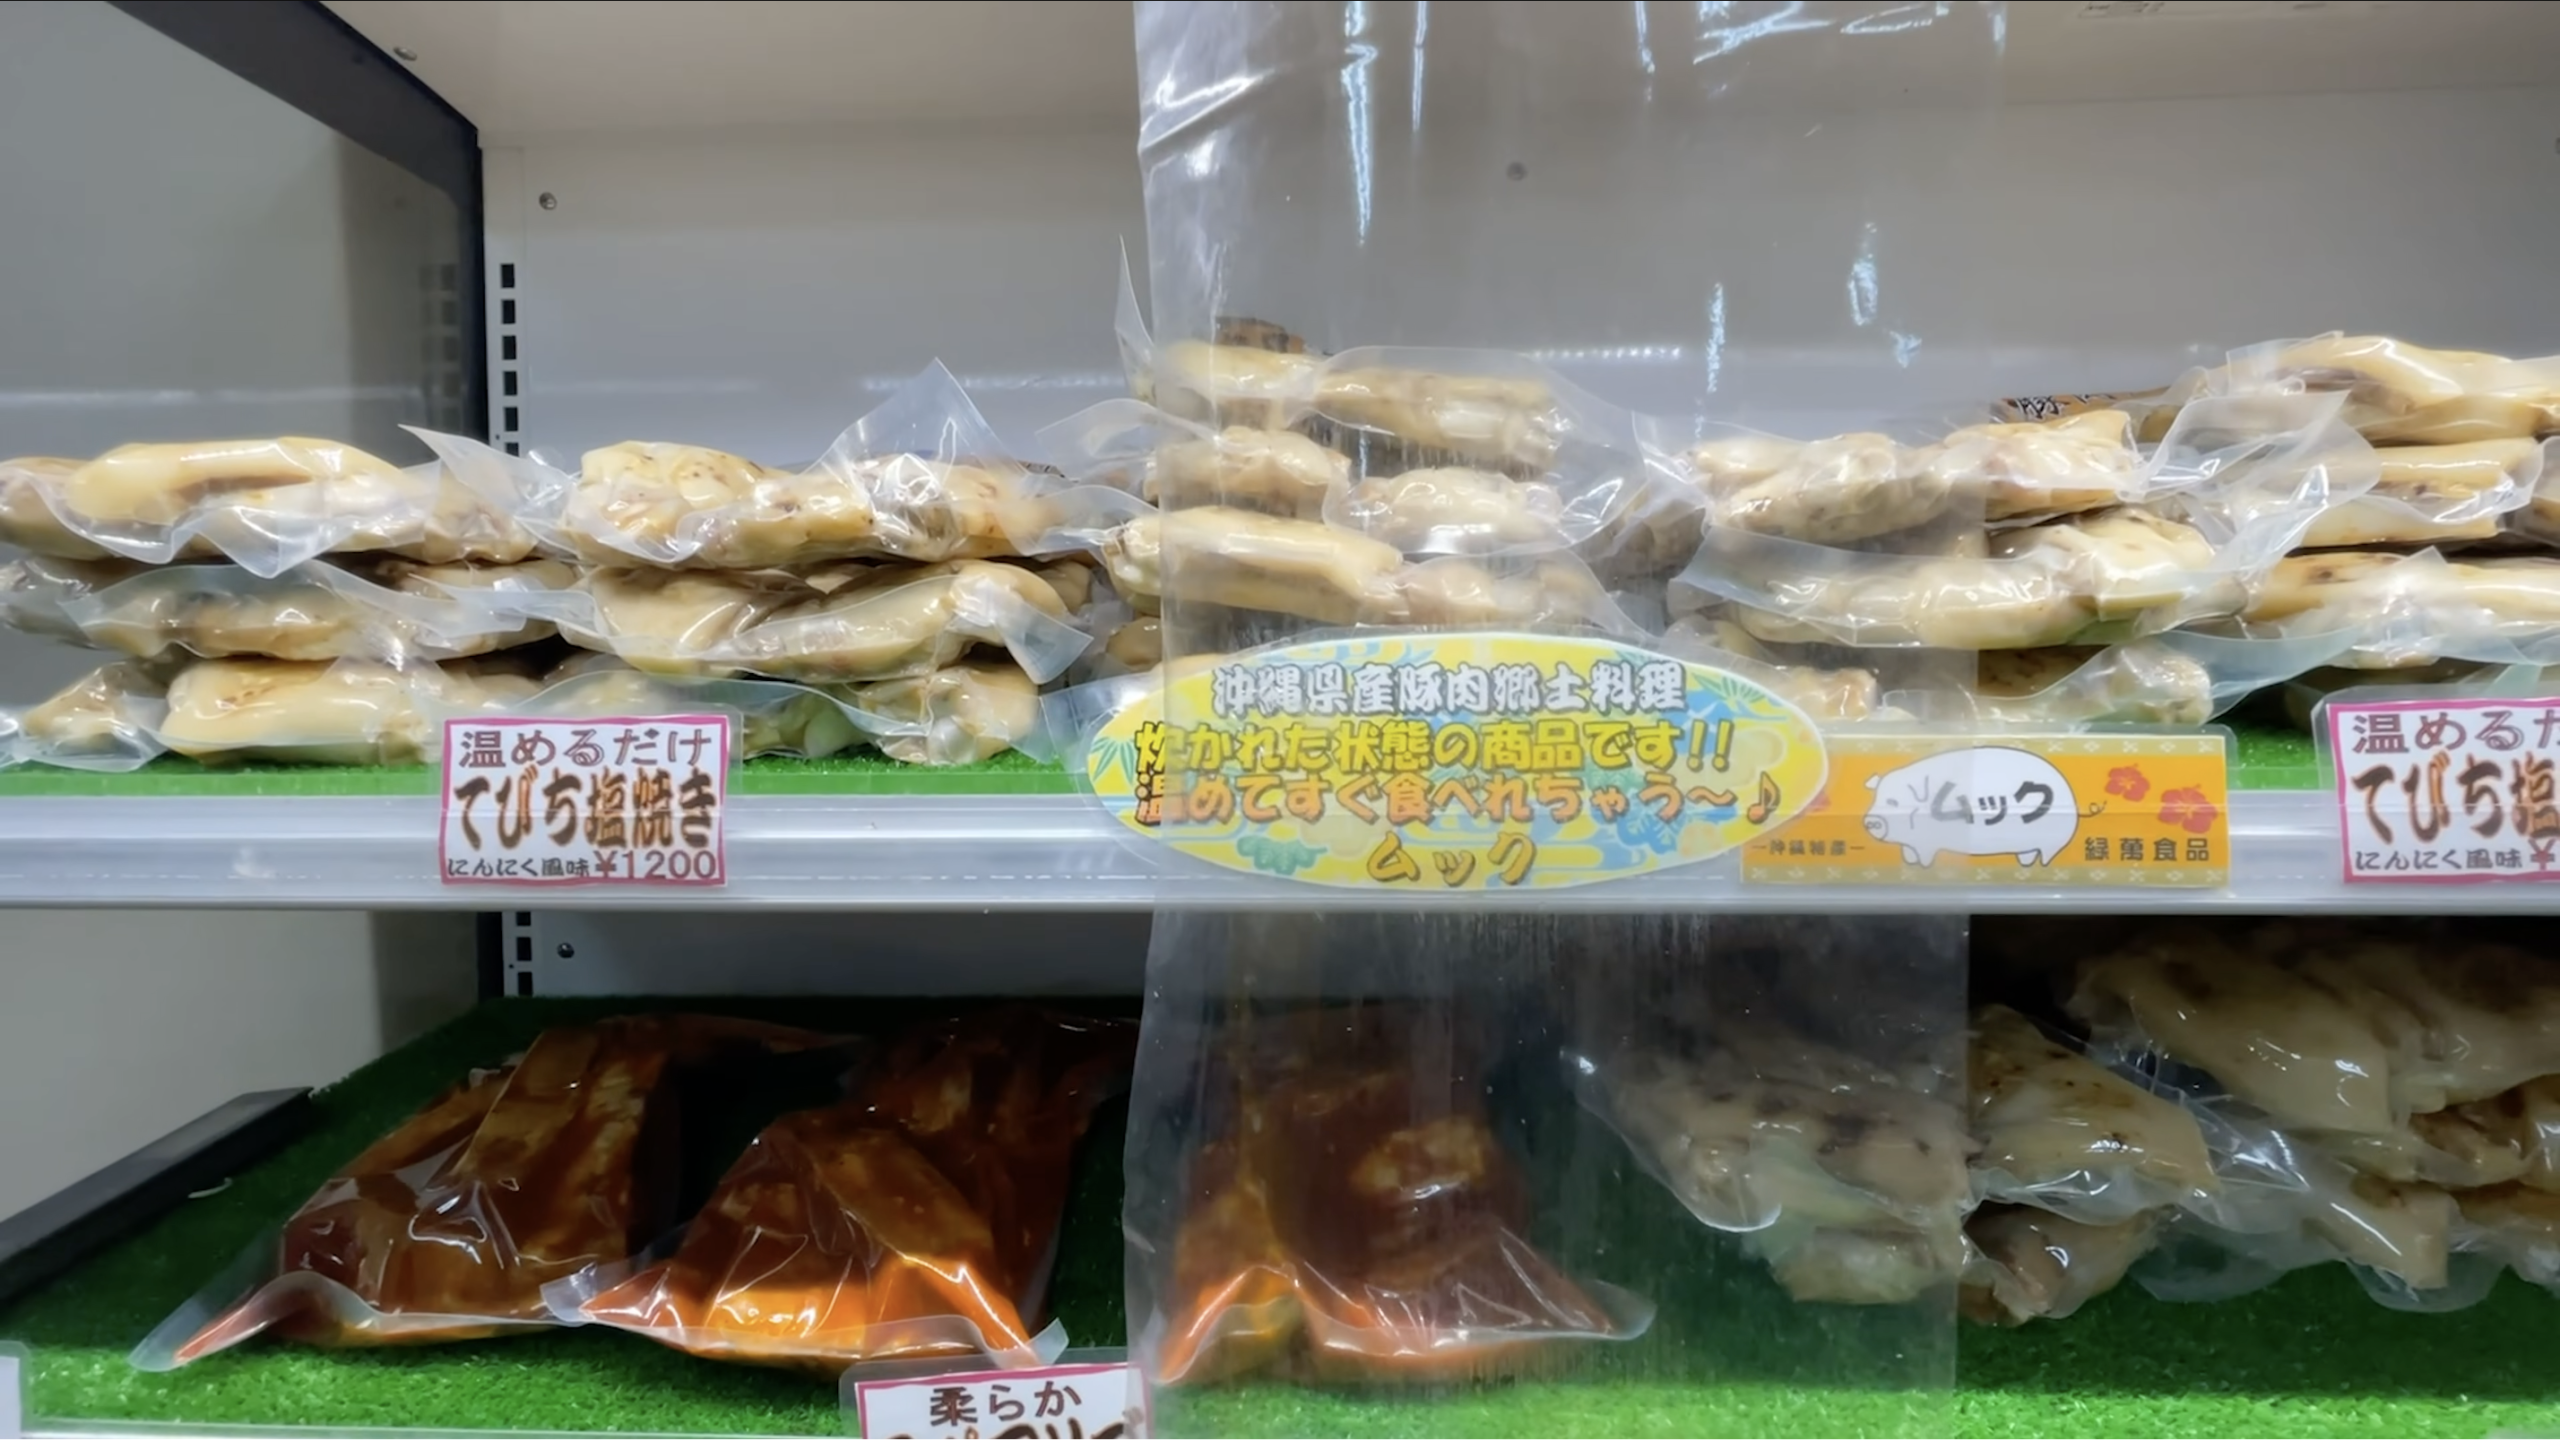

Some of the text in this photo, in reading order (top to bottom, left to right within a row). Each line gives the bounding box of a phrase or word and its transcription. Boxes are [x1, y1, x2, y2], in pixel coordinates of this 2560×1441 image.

[1212, 659, 1688, 717] 沖縄県産豚肉郷土料理
[458, 728, 713, 768] 温めるだけ
[454, 765, 718, 851] てびち塩焼き
[1930, 781, 2054, 826] ムック
[448, 850, 717, 879] にんにく風味 ¥1200
[1366, 830, 1537, 887] ムック
[2355, 848, 2524, 871] にんにく風味
[929, 1380, 1082, 1426] 柔らか
